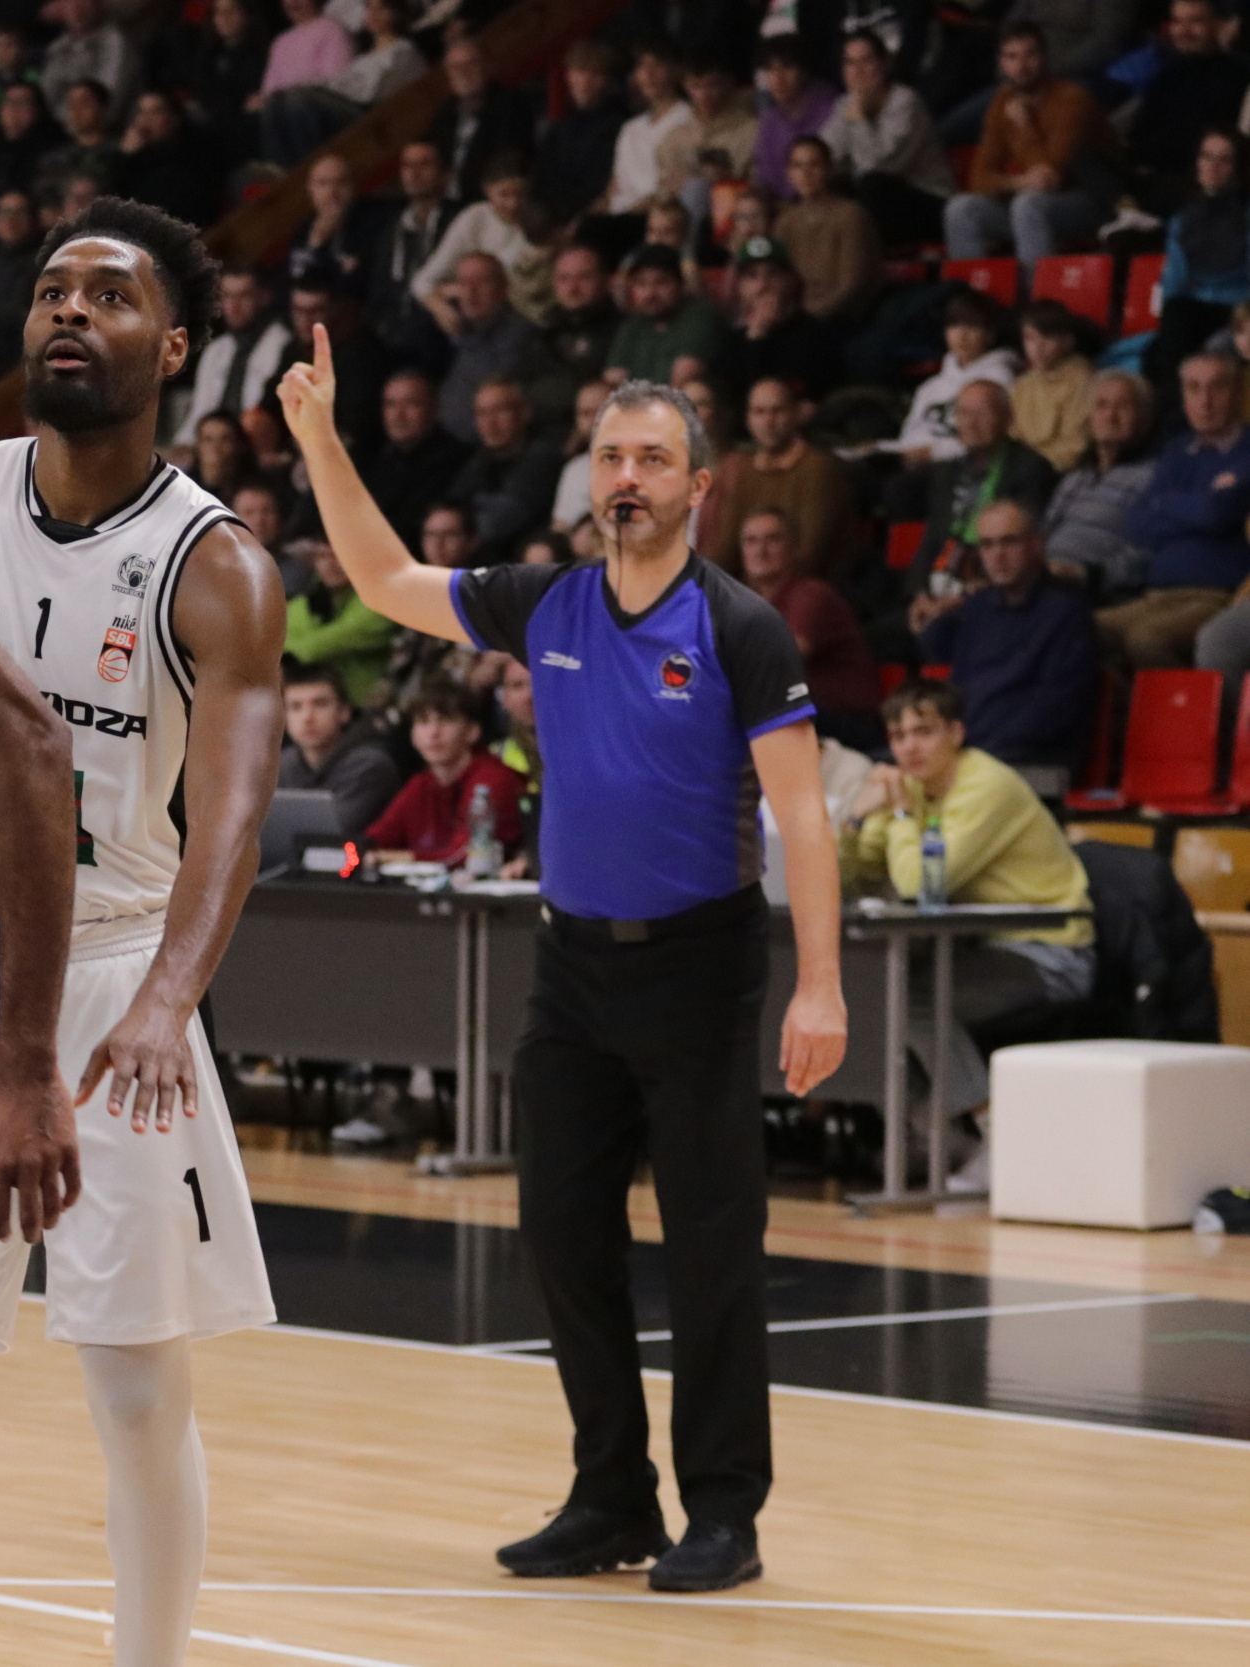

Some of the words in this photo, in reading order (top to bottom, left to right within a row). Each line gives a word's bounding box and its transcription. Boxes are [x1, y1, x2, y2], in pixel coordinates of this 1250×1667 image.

[34, 597, 52, 659] 1
[106, 630, 133, 648] SBL
[112, 615, 137, 632] niké
[182, 1166, 211, 1243] 1
